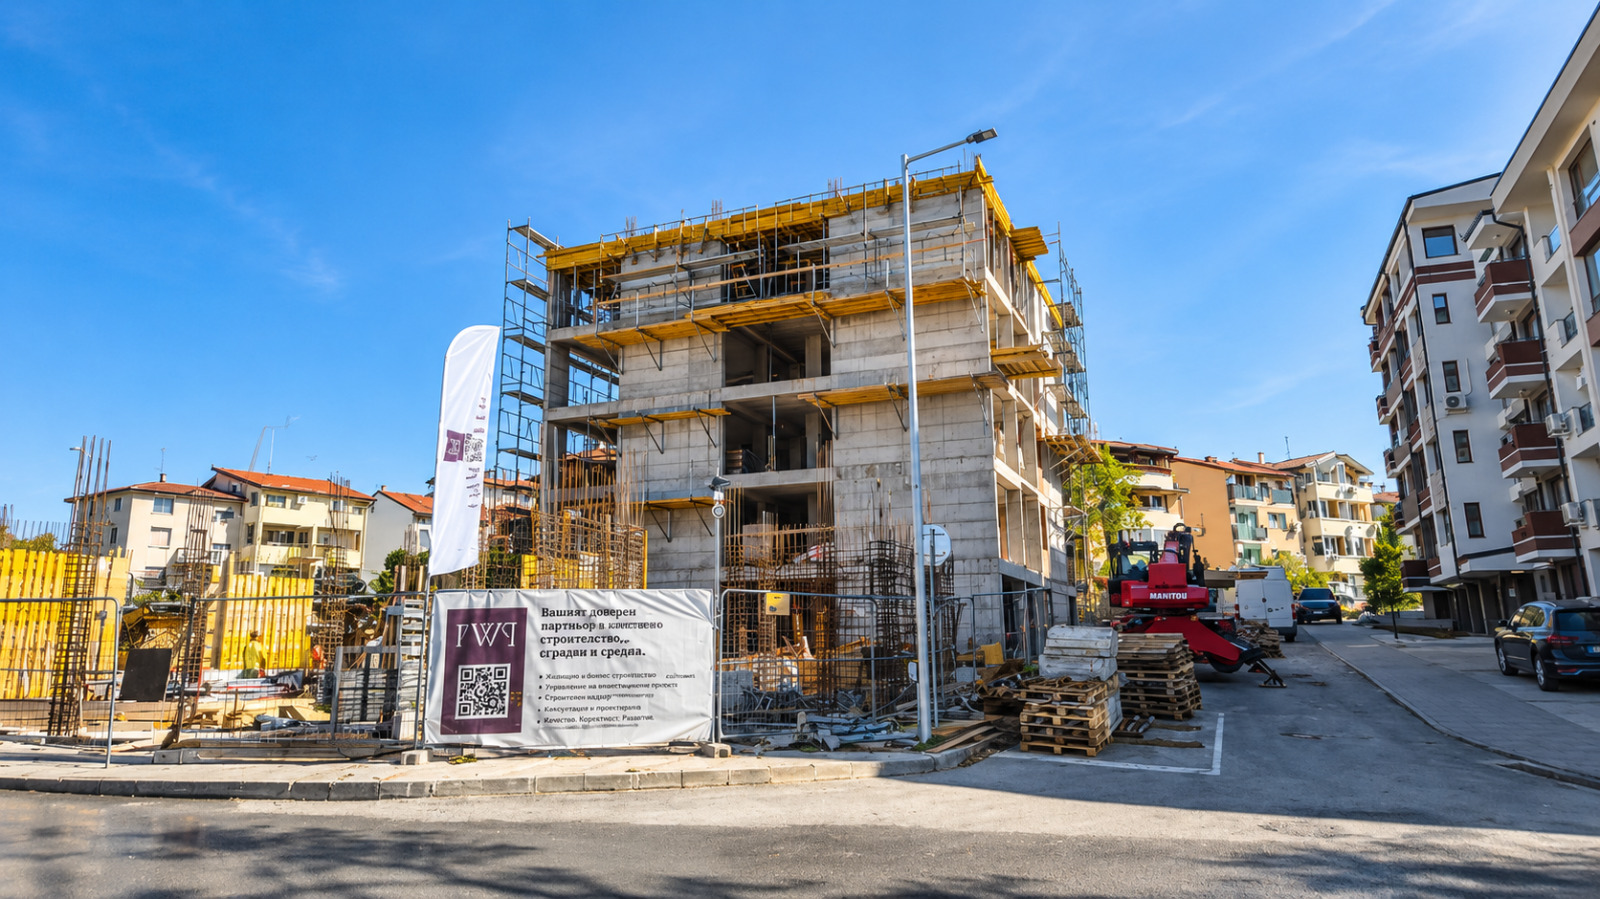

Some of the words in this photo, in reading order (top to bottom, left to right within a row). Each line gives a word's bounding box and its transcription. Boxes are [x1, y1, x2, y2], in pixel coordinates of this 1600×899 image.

[541, 608, 587, 617] Вашият
[589, 608, 636, 619] доверен
[541, 622, 596, 633] партньор
